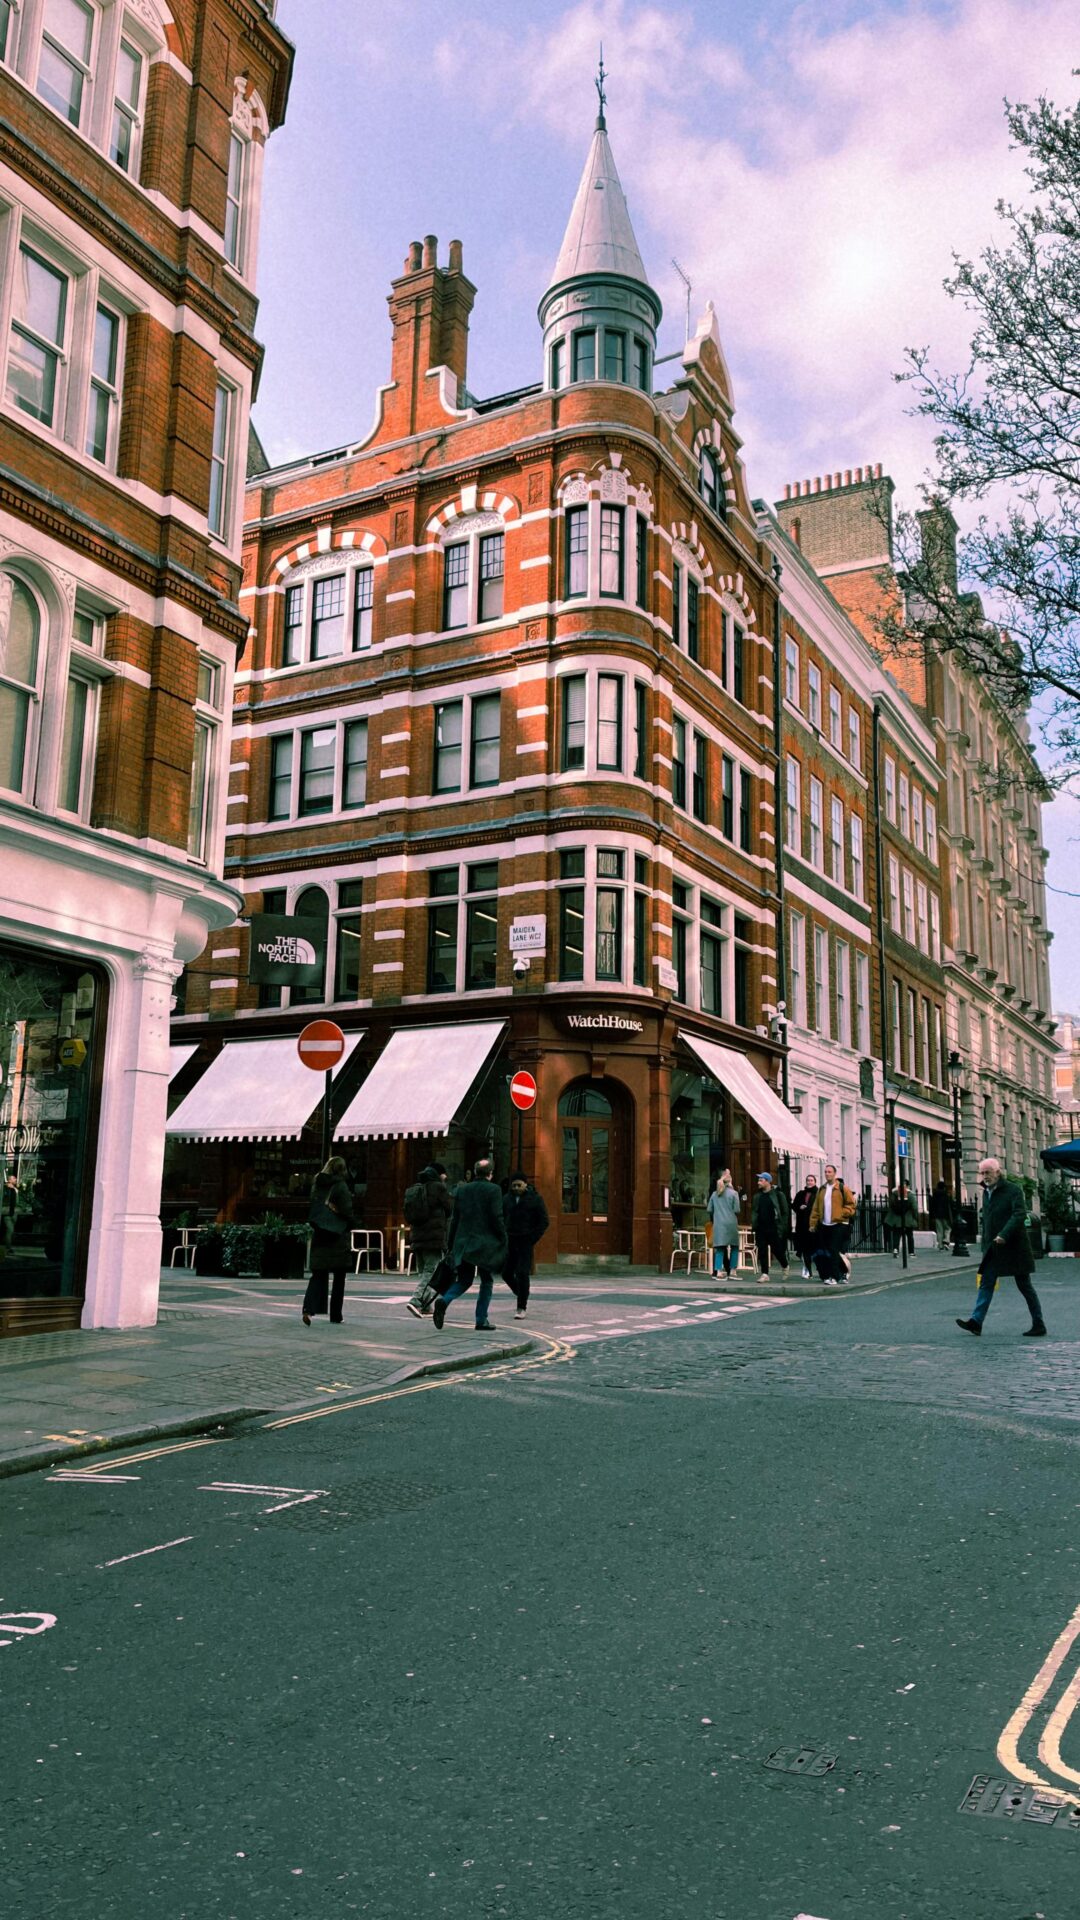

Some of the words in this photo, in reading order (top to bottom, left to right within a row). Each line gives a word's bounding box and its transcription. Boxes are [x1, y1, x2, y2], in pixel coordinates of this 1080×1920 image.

[512, 926, 536, 934] MAIDEN
[275, 936, 297, 946] THE
[529, 932, 542, 940] WC2
[258, 943, 296, 955] NORTH
[268, 953, 296, 964] FACE
